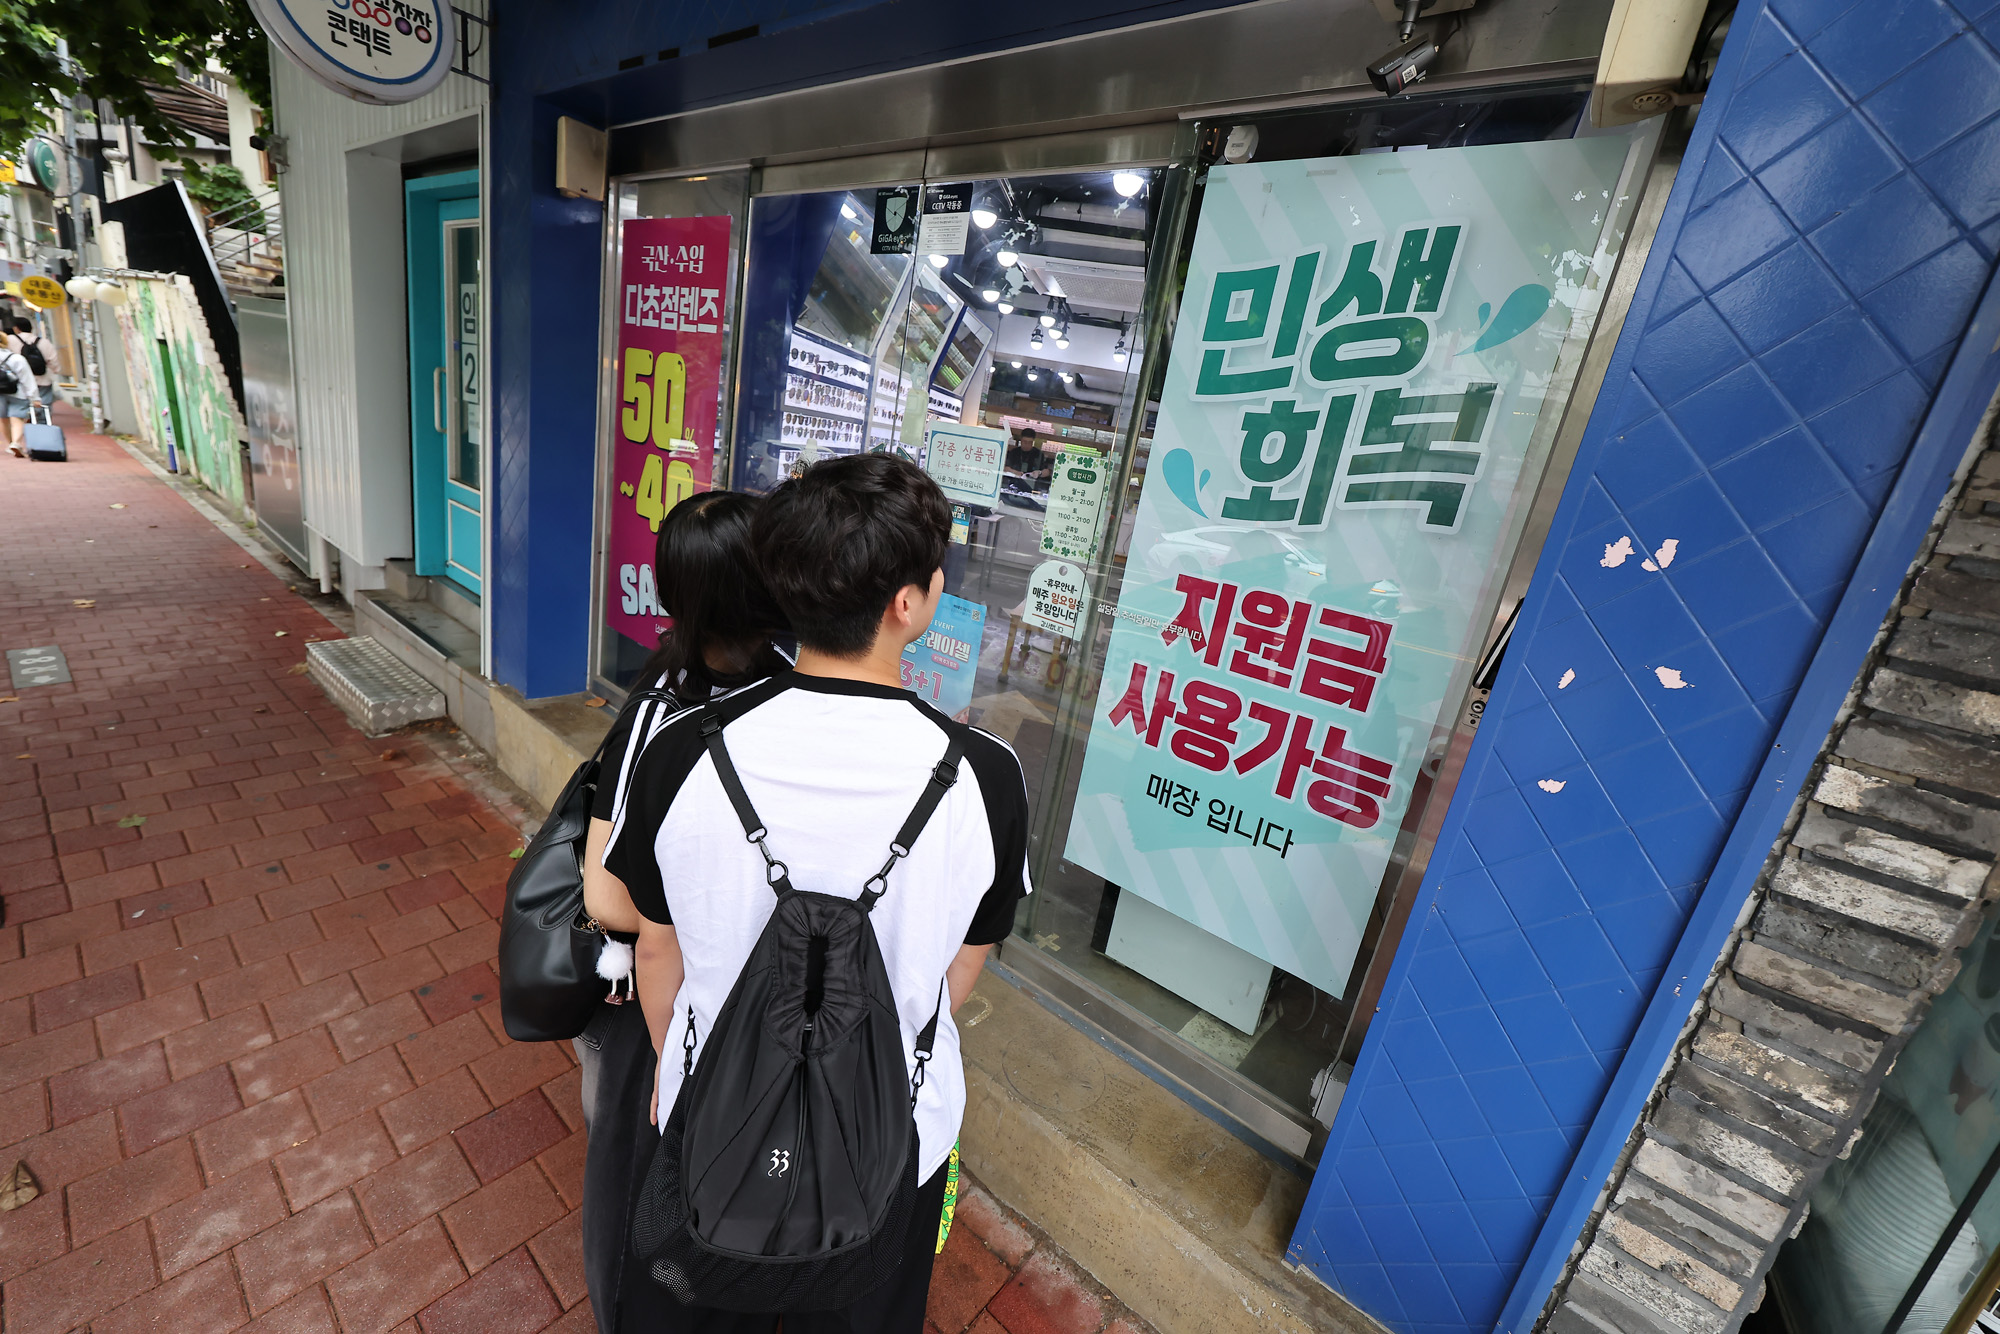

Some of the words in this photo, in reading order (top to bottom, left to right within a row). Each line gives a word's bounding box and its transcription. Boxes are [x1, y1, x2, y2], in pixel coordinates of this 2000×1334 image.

[327, 9, 393, 57] 콘택트
[932, 202, 946, 210] CCTV
[462, 291, 476, 334] 임
[625, 283, 720, 334] 다초점렌즈
[1194, 224, 1462, 397] 민생
[464, 352, 476, 395] 2
[937, 441, 957, 458] 각종
[962, 445, 996, 464] 상품권
[1220, 381, 1500, 528] 회복
[1057, 512, 1072, 522] 11:00
[1076, 515, 1091, 525] 21:00
[1060, 494, 1075, 504] 10:30
[1079, 497, 1095, 507] 21:00
[1054, 530, 1069, 540] 11:00
[1072, 533, 1088, 544] 20:00
[1032, 587, 1049, 601] 매주
[1051, 592, 1085, 613] 일요일은
[1034, 600, 1078, 624] 휴일입니다
[934, 619, 955, 632] EVENT
[1040, 619, 1064, 634] 감사합니다
[1160, 572, 1394, 714] 지원금
[900, 657, 943, 702] 3+1
[1107, 661, 1395, 830] 사용가능
[1145, 773, 1201, 818] 매장
[1206, 797, 1295, 860] 입니다
